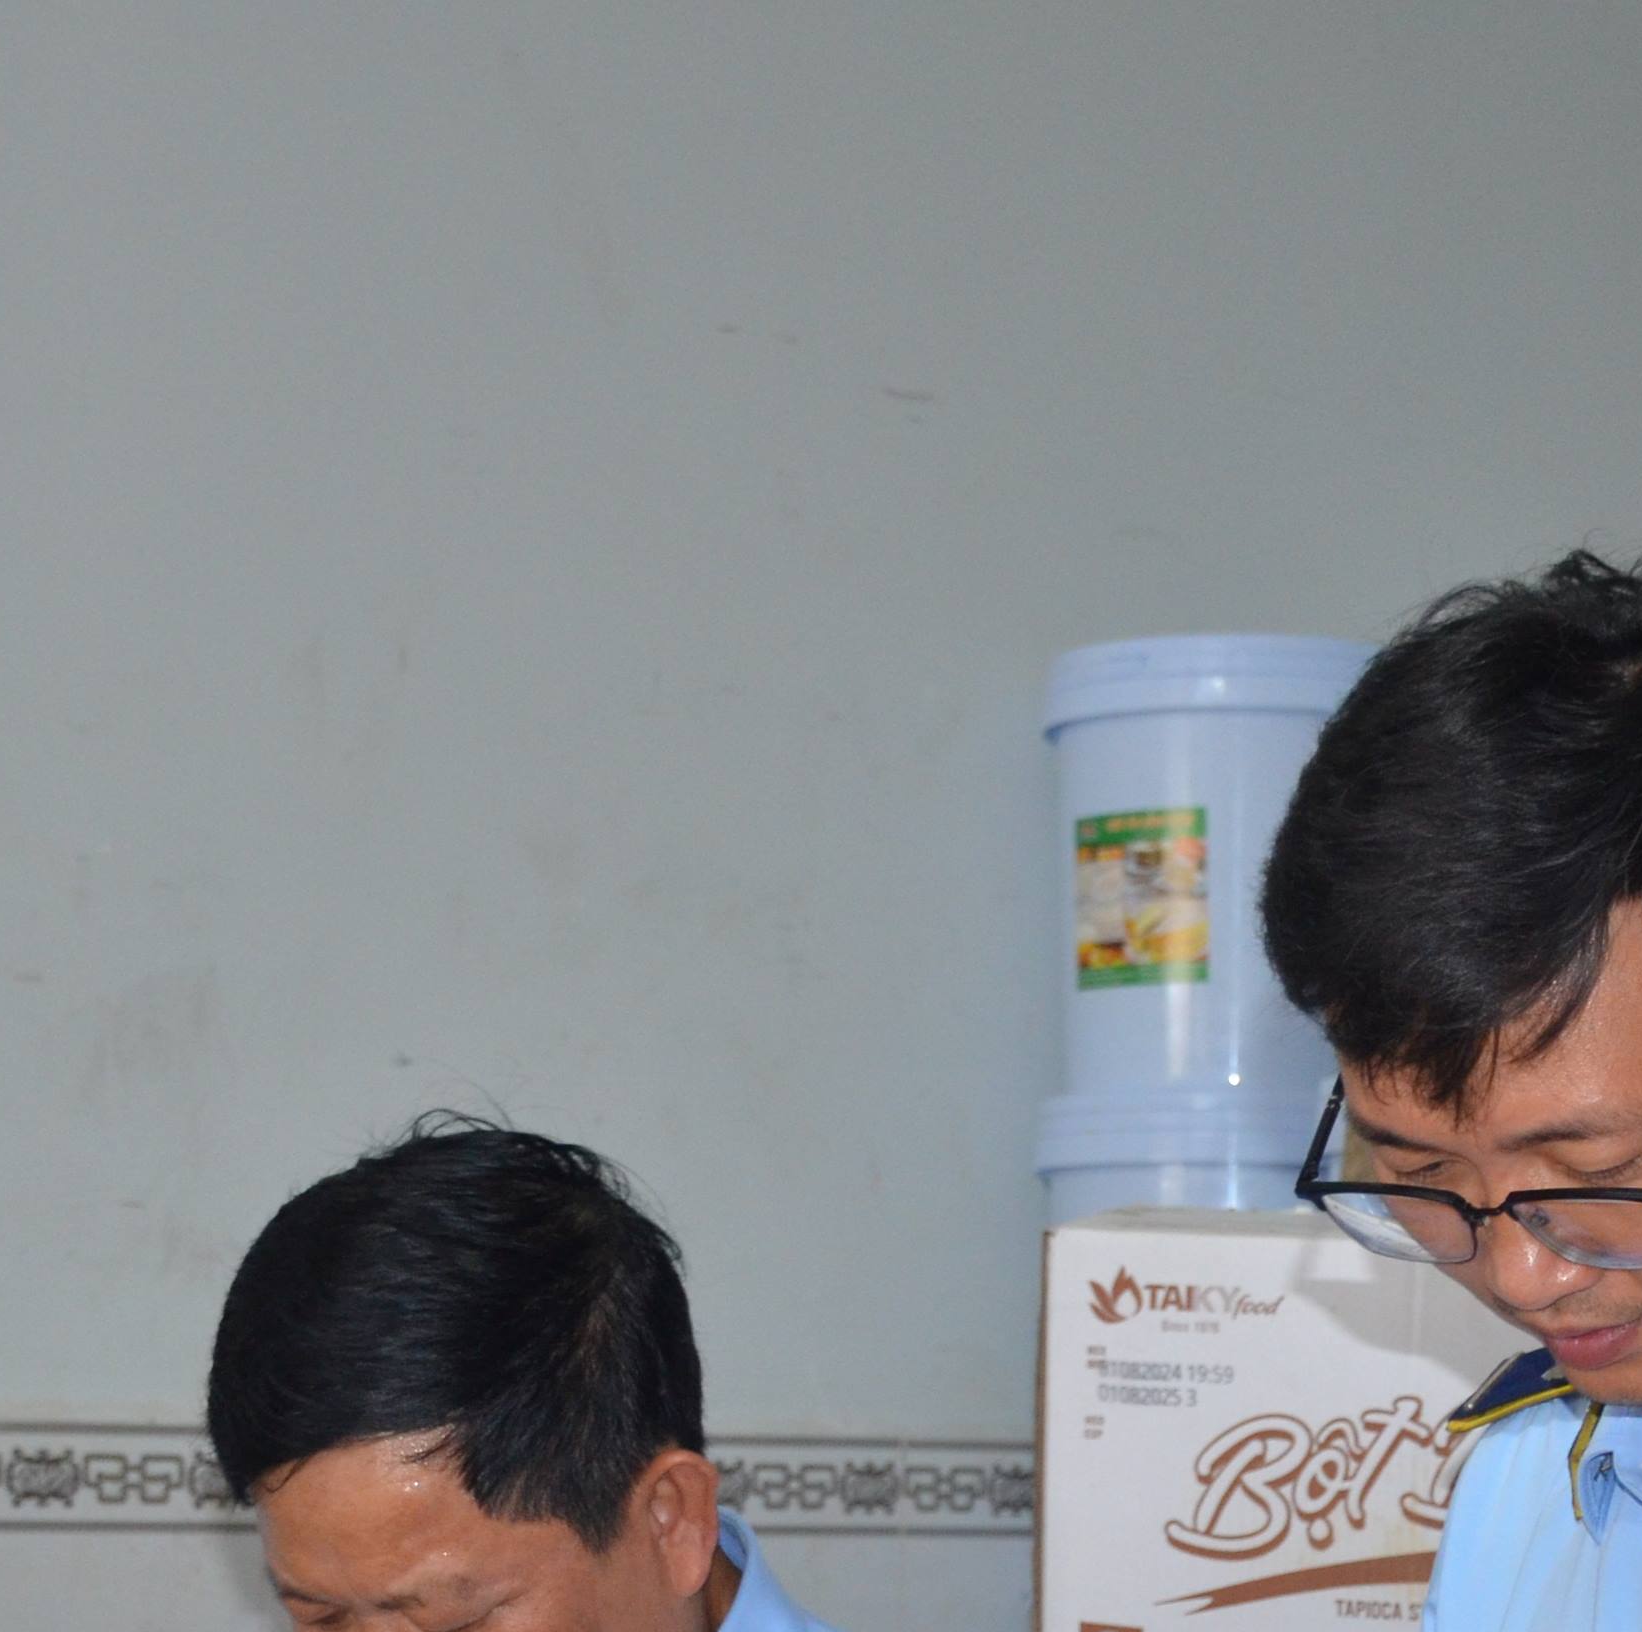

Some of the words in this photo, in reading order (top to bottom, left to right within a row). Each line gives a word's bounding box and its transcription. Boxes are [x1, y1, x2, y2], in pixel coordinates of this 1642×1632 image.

[1187, 1365, 1235, 1384] 19:59
[1097, 1384, 1181, 1406] 01082025
[1187, 1389, 1198, 1407] 3
[1336, 1599, 1402, 1621] TAPIOCA
